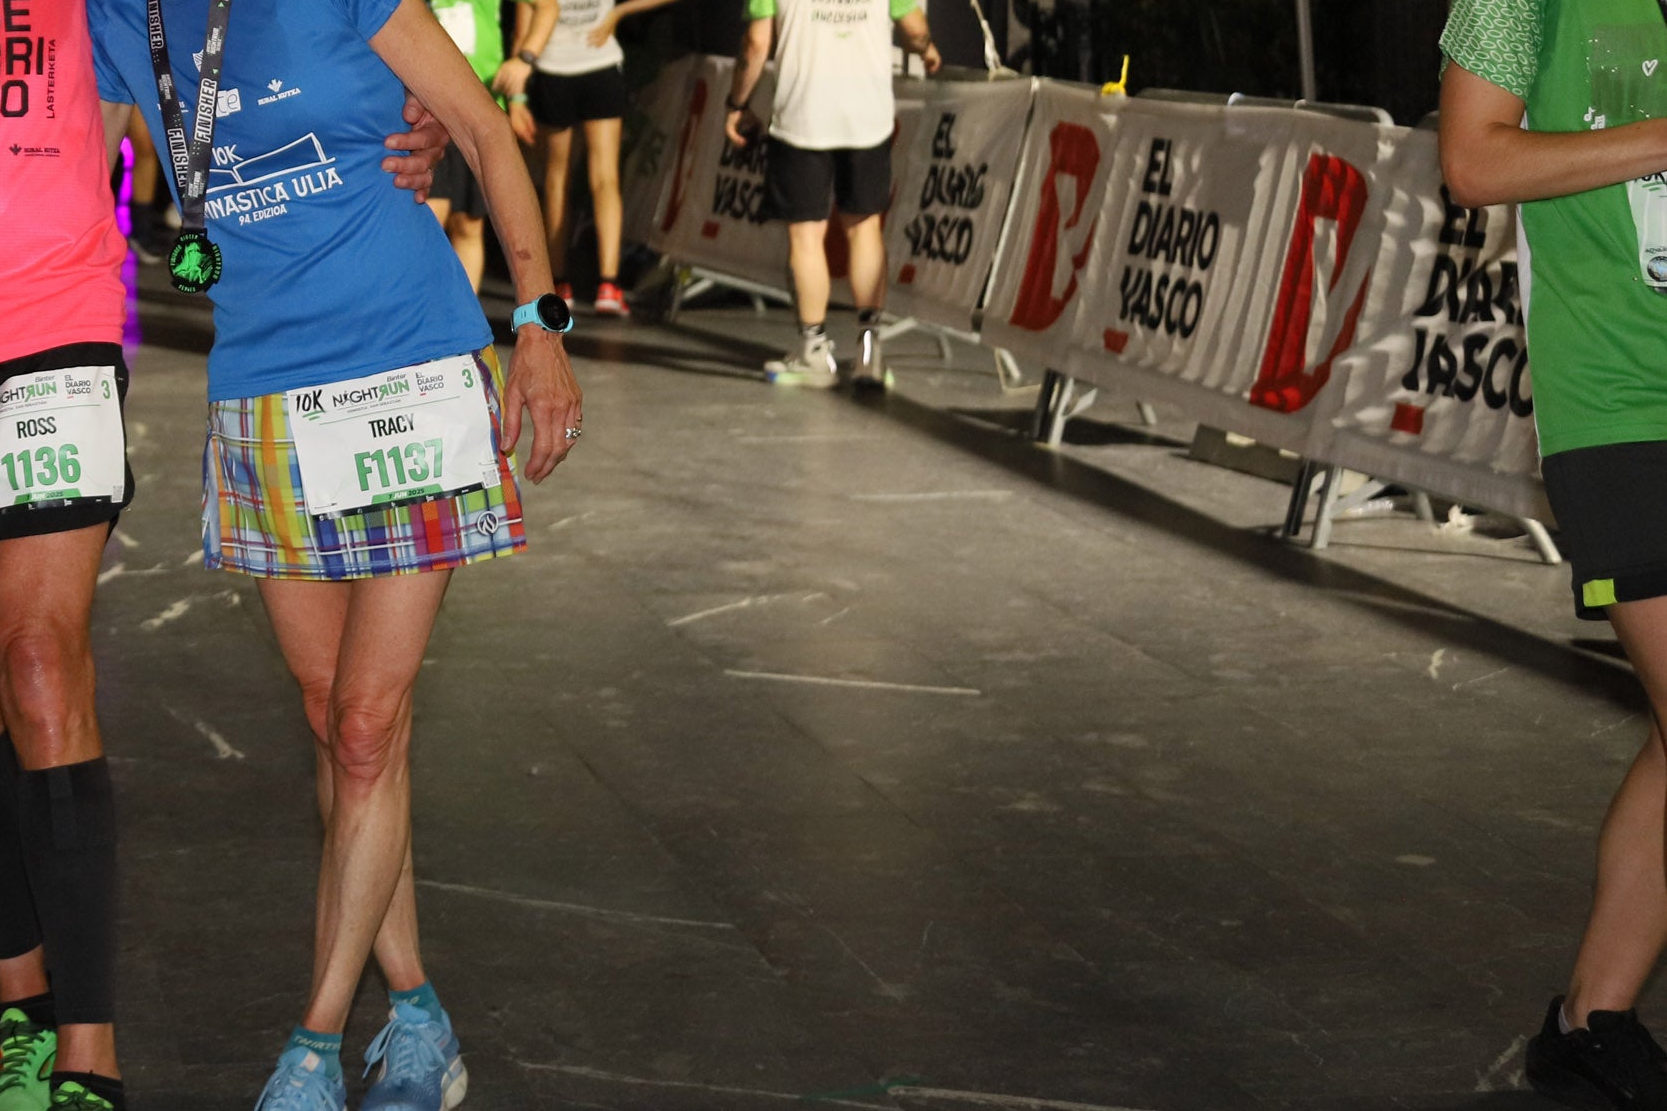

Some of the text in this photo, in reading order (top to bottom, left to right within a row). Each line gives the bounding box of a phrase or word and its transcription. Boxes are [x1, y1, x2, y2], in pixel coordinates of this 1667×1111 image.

[46, 38, 57, 119] LASTERKETA
[193, 77, 218, 143] FINISHER
[932, 112, 956, 159] EL
[212, 144, 244, 166] 10K
[1143, 137, 1172, 196] EL
[291, 167, 344, 198] ULIA
[253, 204, 288, 222] EDIZIOA
[1128, 200, 1220, 271] DIARIO
[1119, 265, 1203, 339] VASCO
[65, 380, 91, 389] DIARIO
[66, 387, 91, 395] VASCO
[101, 379, 111, 400] 3
[417, 374, 444, 386] DIARIO
[418, 382, 445, 392] VASCO
[461, 368, 474, 389] 3
[296, 389, 325, 414] 10K
[16, 416, 57, 439] ROSS
[368, 412, 415, 438] TRACY
[1, 443, 81, 491] 1136
[354, 438, 444, 492] F1137
